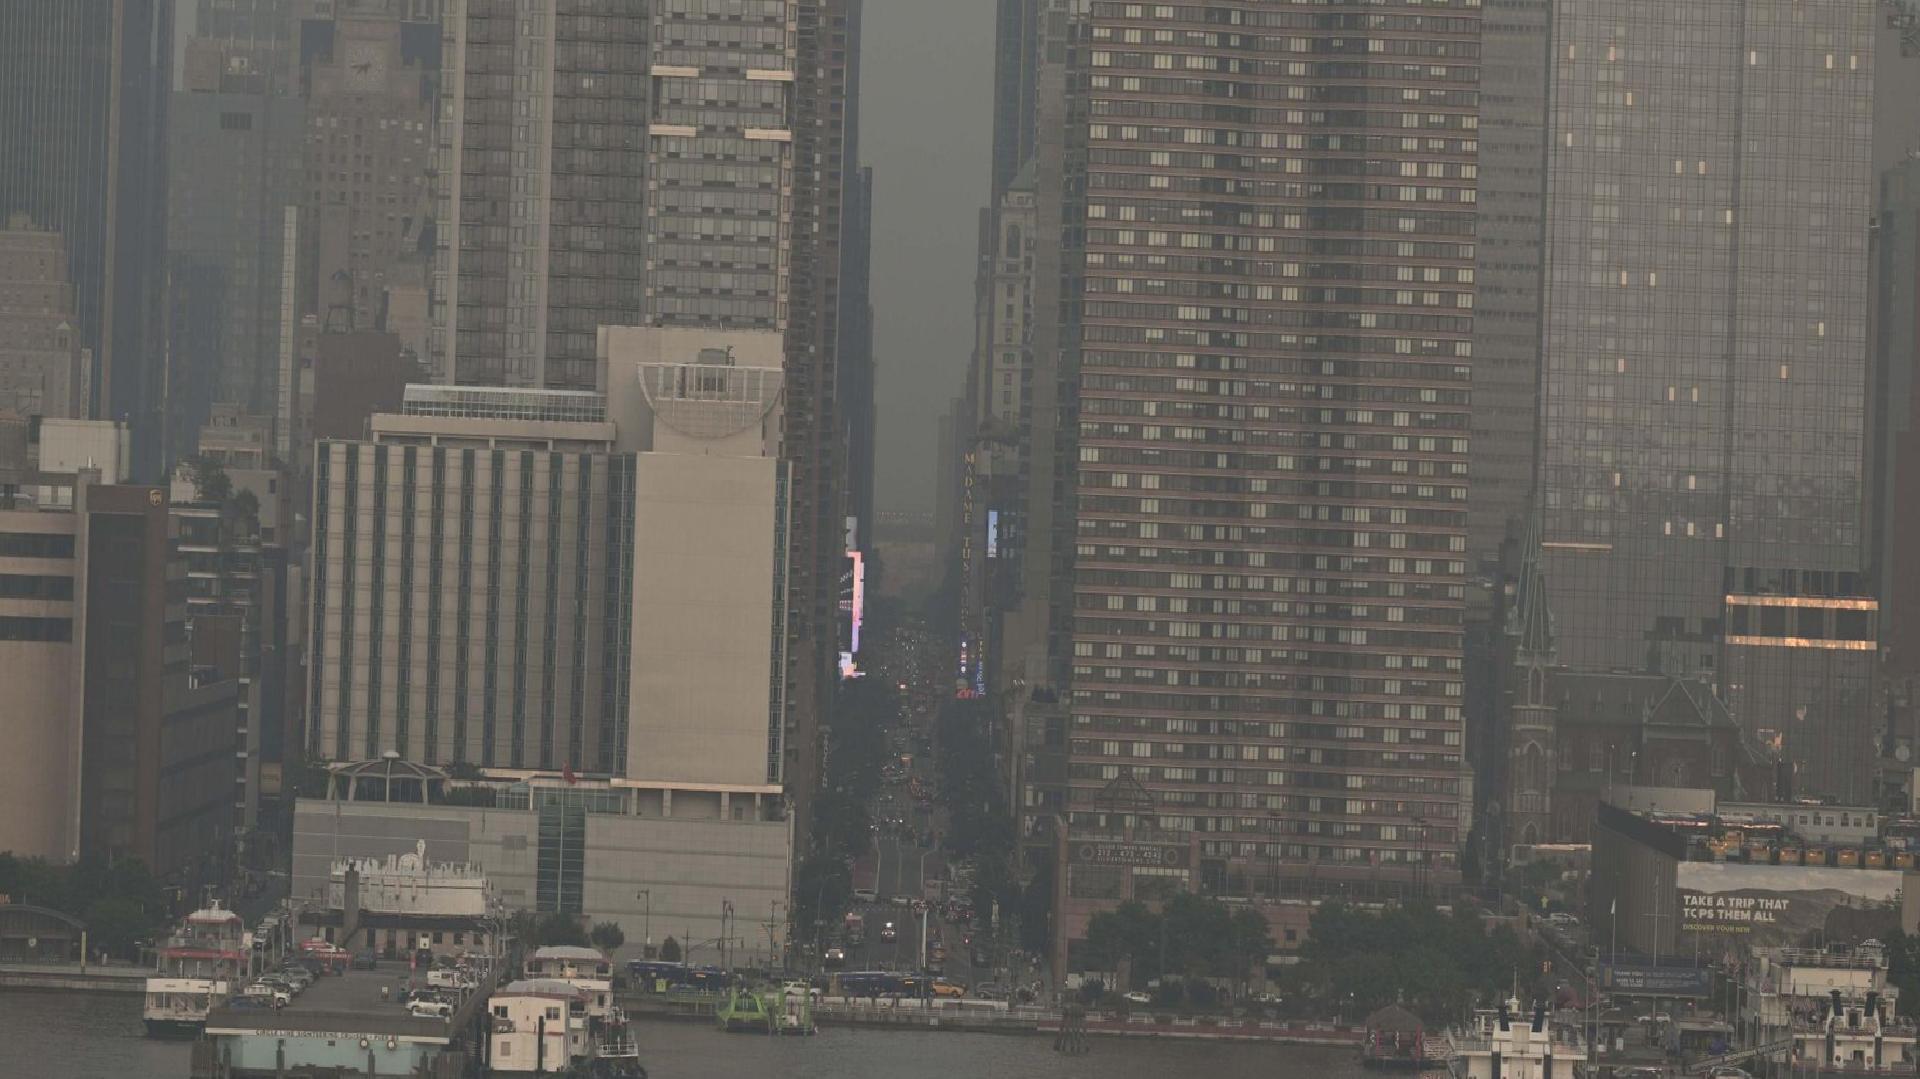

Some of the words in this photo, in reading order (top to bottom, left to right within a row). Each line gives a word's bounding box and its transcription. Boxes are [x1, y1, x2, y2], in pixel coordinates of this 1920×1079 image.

[1683, 895, 1713, 906] TAKE
[1716, 896, 1725, 907] A
[1728, 898, 1755, 908] TRIP
[1758, 899, 1789, 910] THAT
[1683, 908, 1714, 920] TOPS
[1718, 909, 1751, 921] THEM
[1754, 911, 1776, 921] ALL
